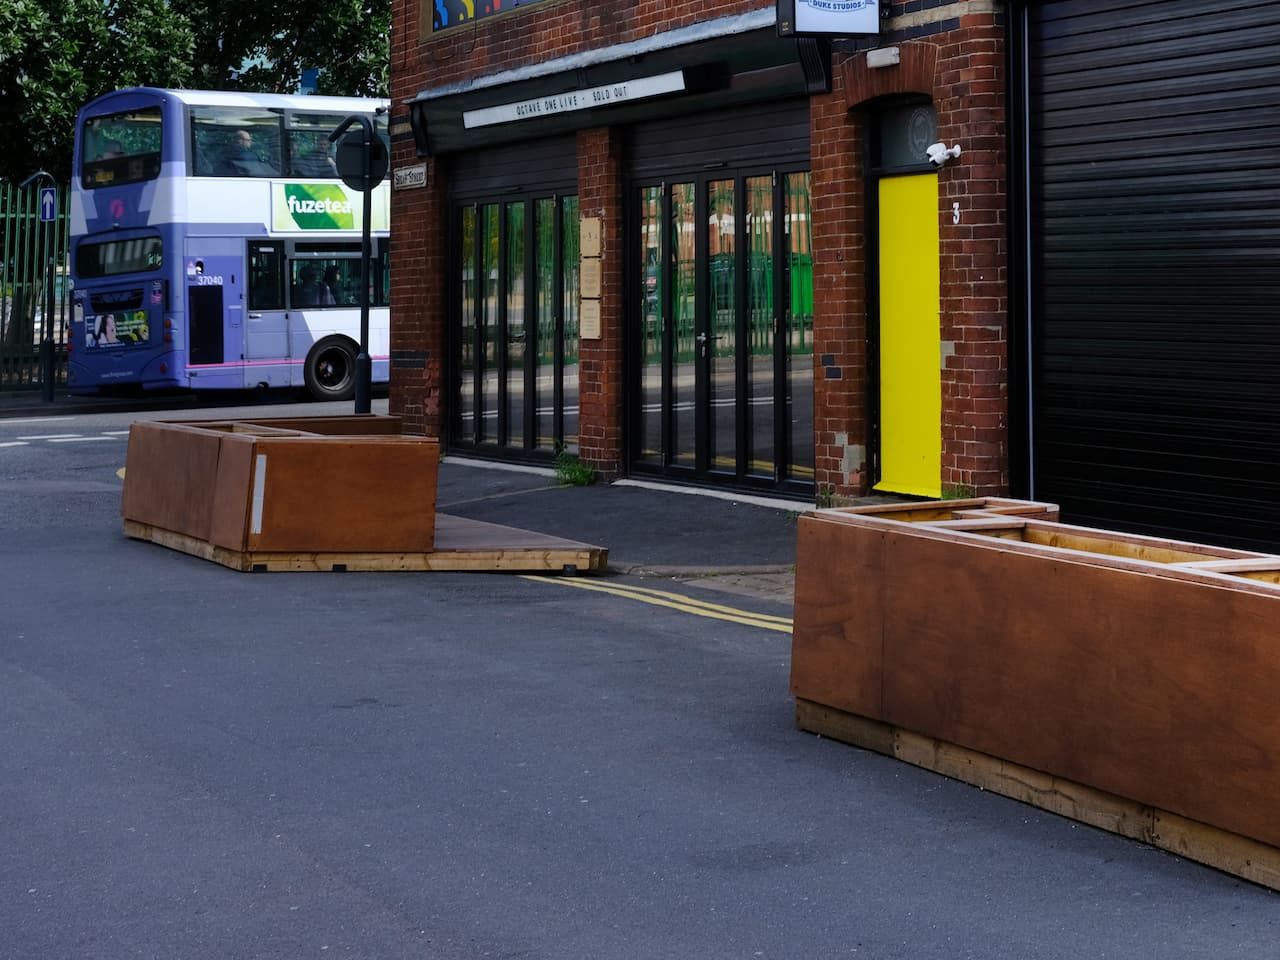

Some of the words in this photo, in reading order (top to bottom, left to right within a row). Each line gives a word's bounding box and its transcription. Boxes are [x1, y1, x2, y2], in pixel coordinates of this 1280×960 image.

[812, 0, 831, 9] DUKE
[832, 0, 862, 10] STUDIOS
[516, 102, 541, 115] OCTAVE
[544, 99, 557, 110] ONE
[559, 95, 577, 108] LIVE
[592, 89, 610, 102] SOLD
[613, 86, 628, 97] OUT
[287, 194, 352, 214] fuzetea
[197, 275, 224, 286] 37040
